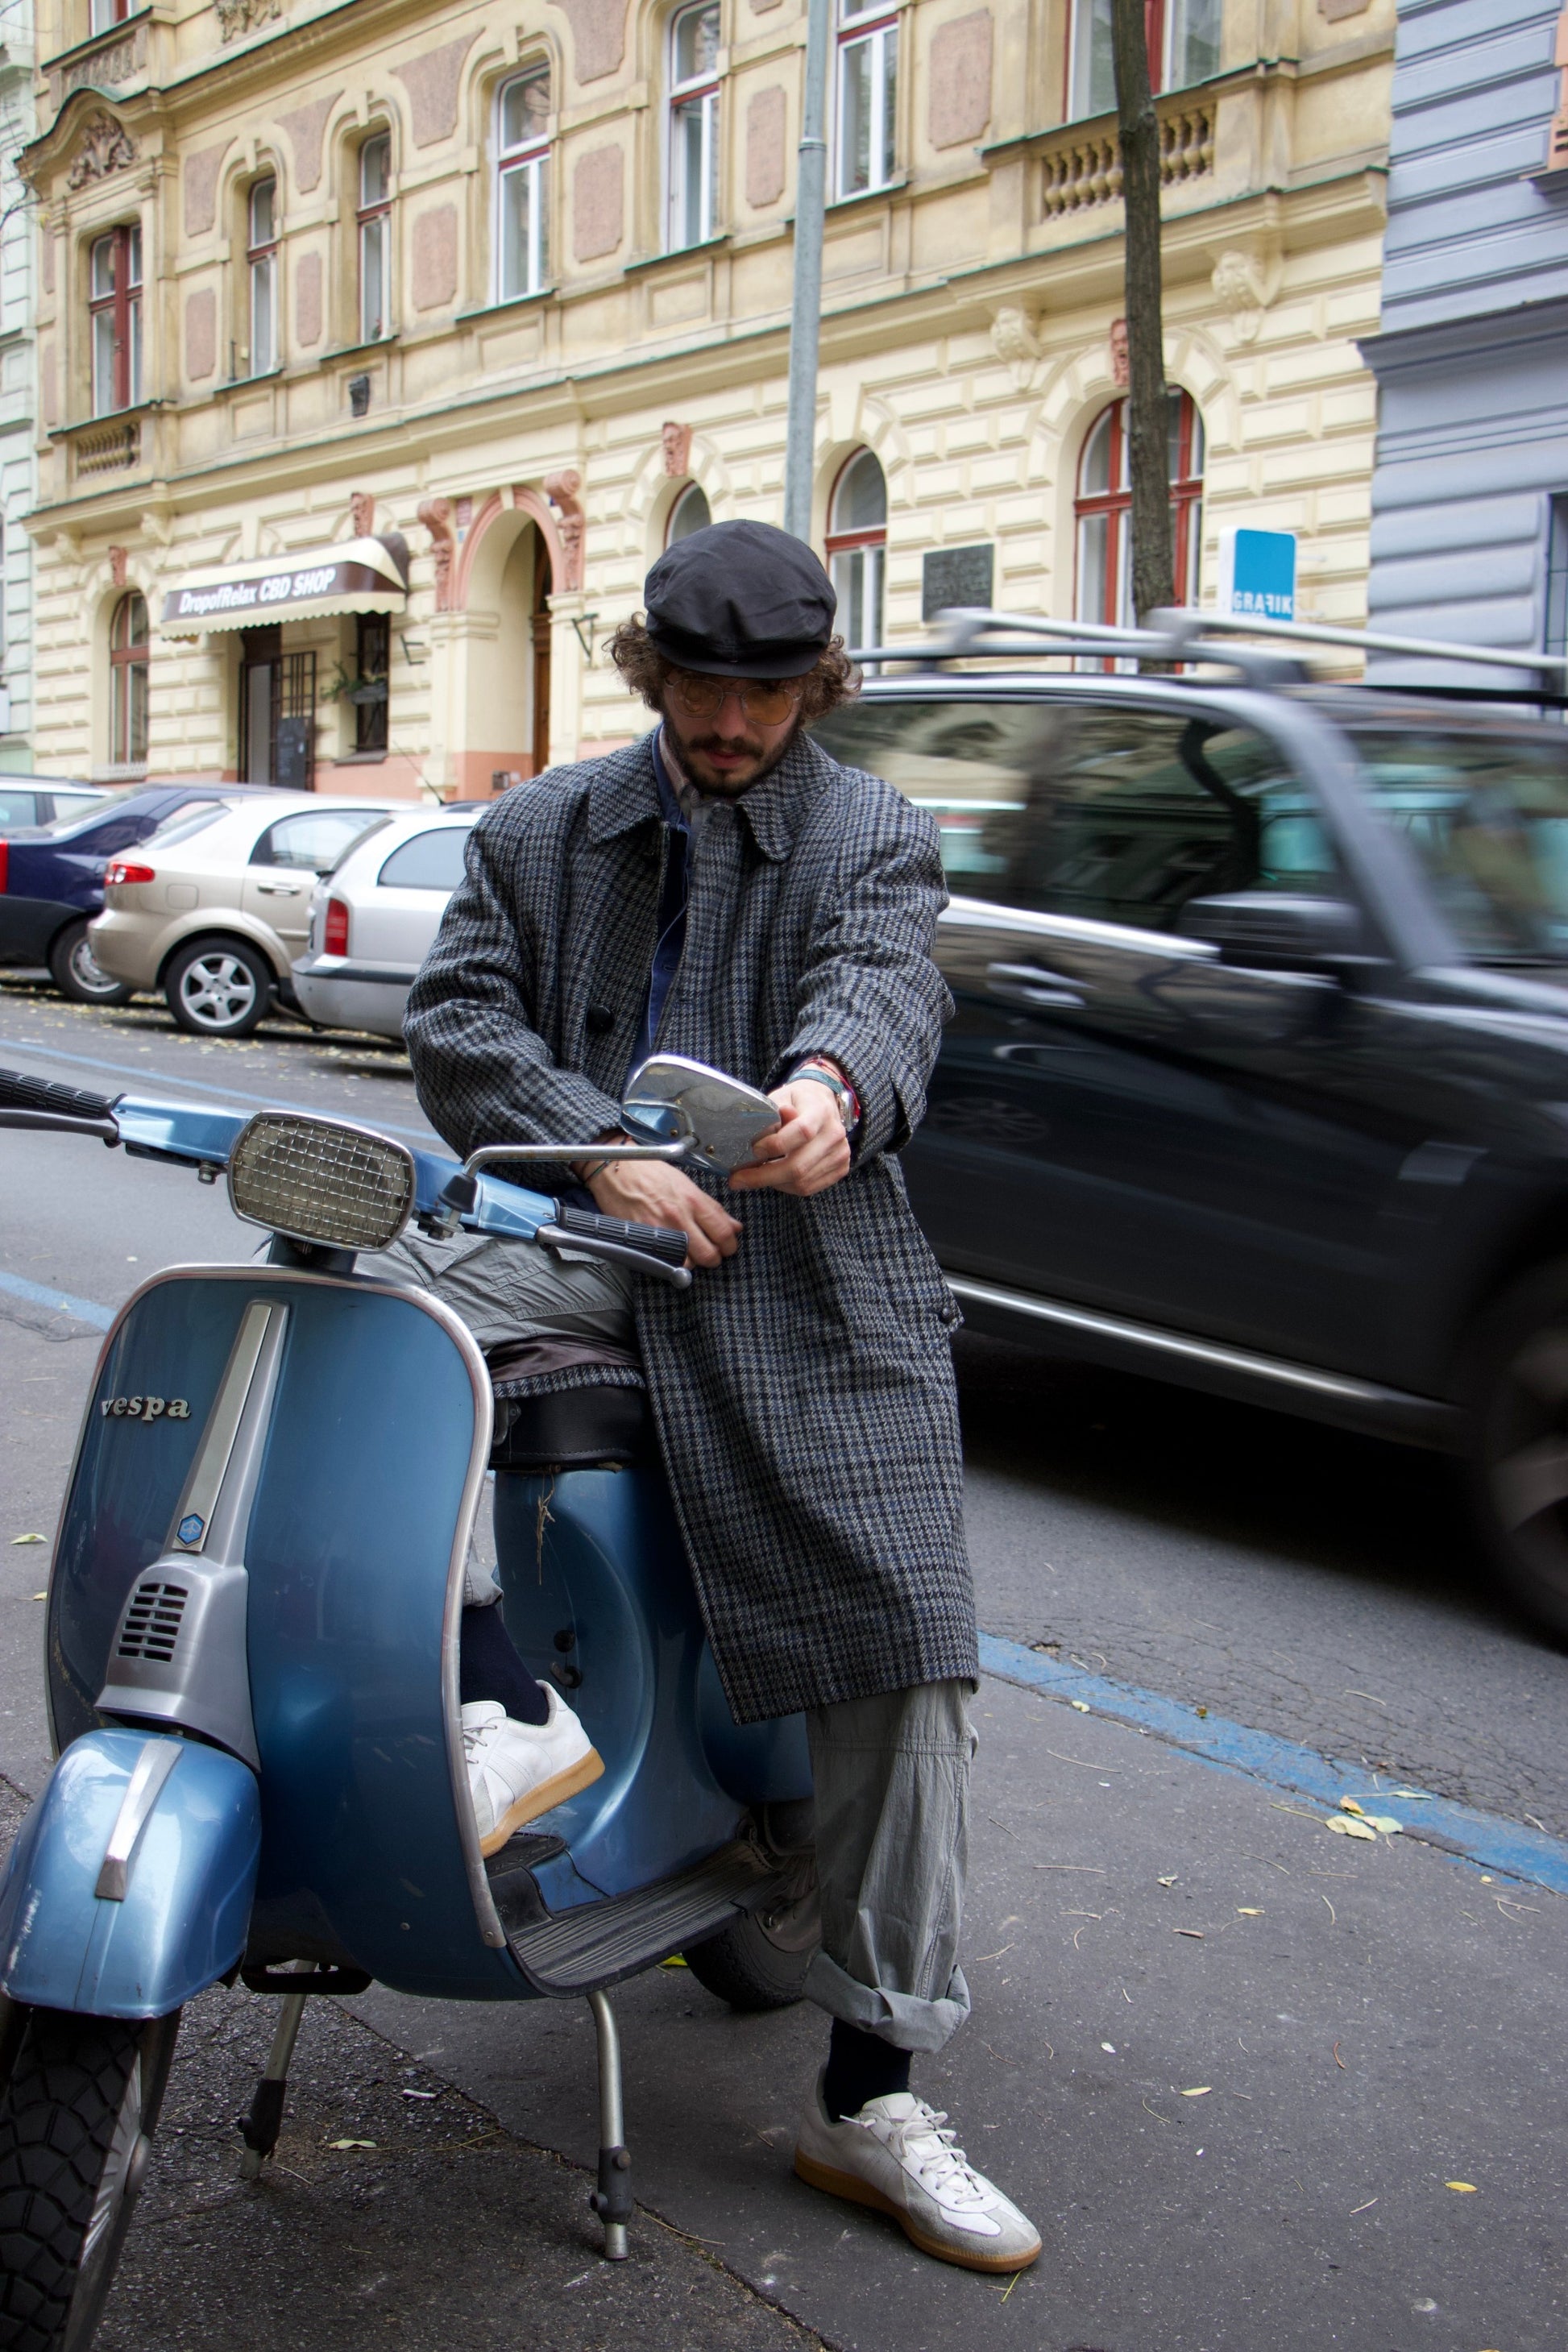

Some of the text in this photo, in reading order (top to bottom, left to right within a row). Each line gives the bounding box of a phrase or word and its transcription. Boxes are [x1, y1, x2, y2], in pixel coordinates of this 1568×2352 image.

[179, 566, 336, 614] DropofRelax CBD SHOP
[1233, 591, 1292, 614] GRAFIK
[102, 1396, 191, 1421] vespa
